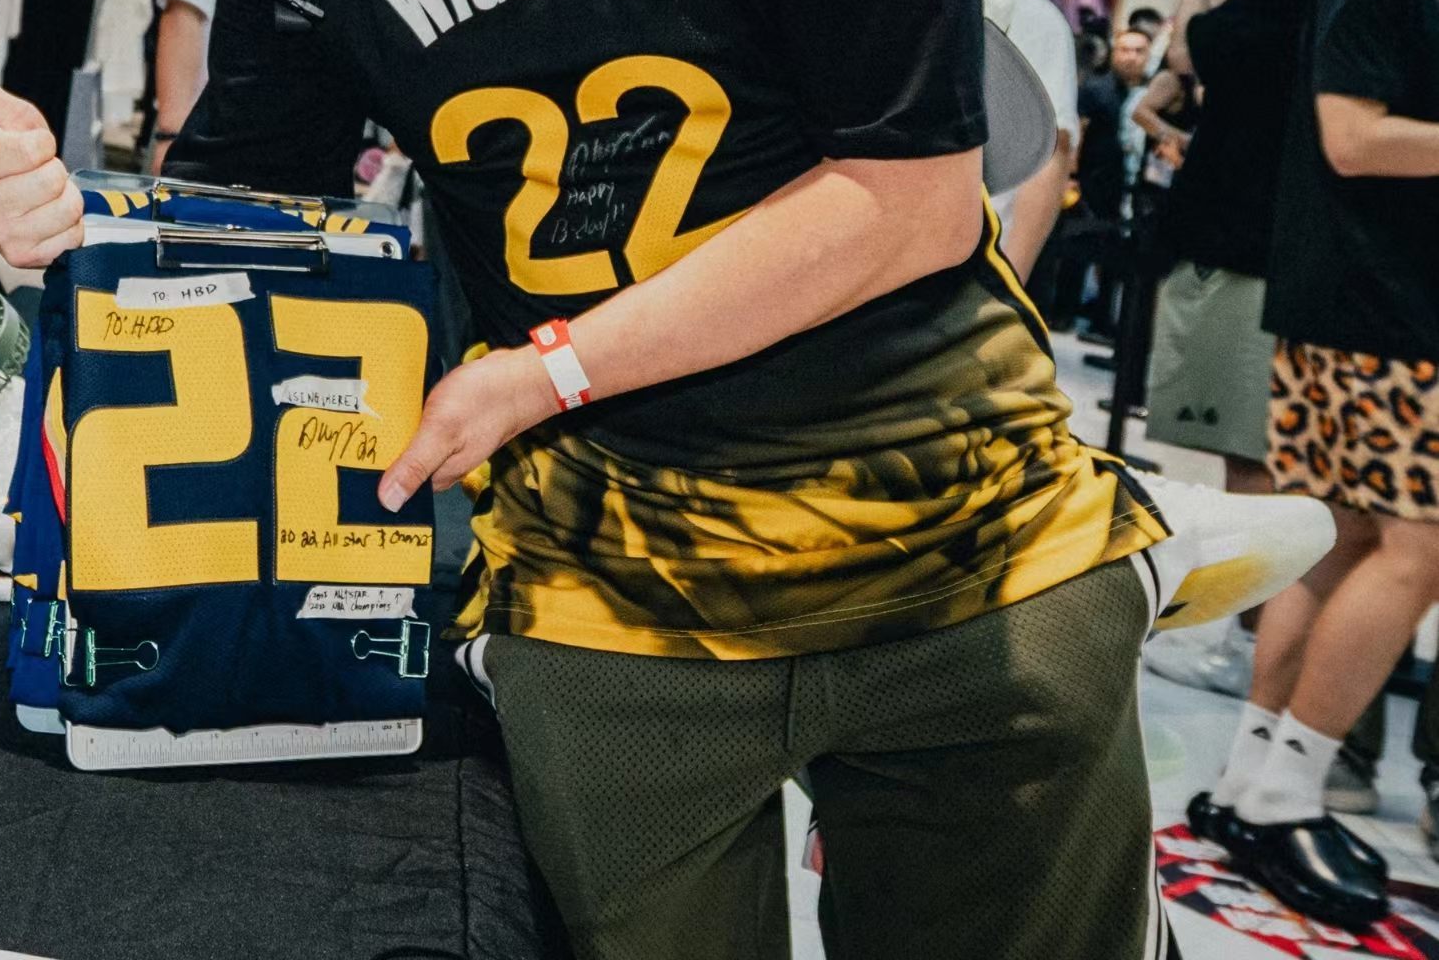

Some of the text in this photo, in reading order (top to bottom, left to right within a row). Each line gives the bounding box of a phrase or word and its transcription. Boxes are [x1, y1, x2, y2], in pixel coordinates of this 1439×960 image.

[430, 54, 755, 296] 22
[131, 315, 175, 338] HBD
[181, 283, 218, 301] HBD
[67, 286, 434, 591] 22
